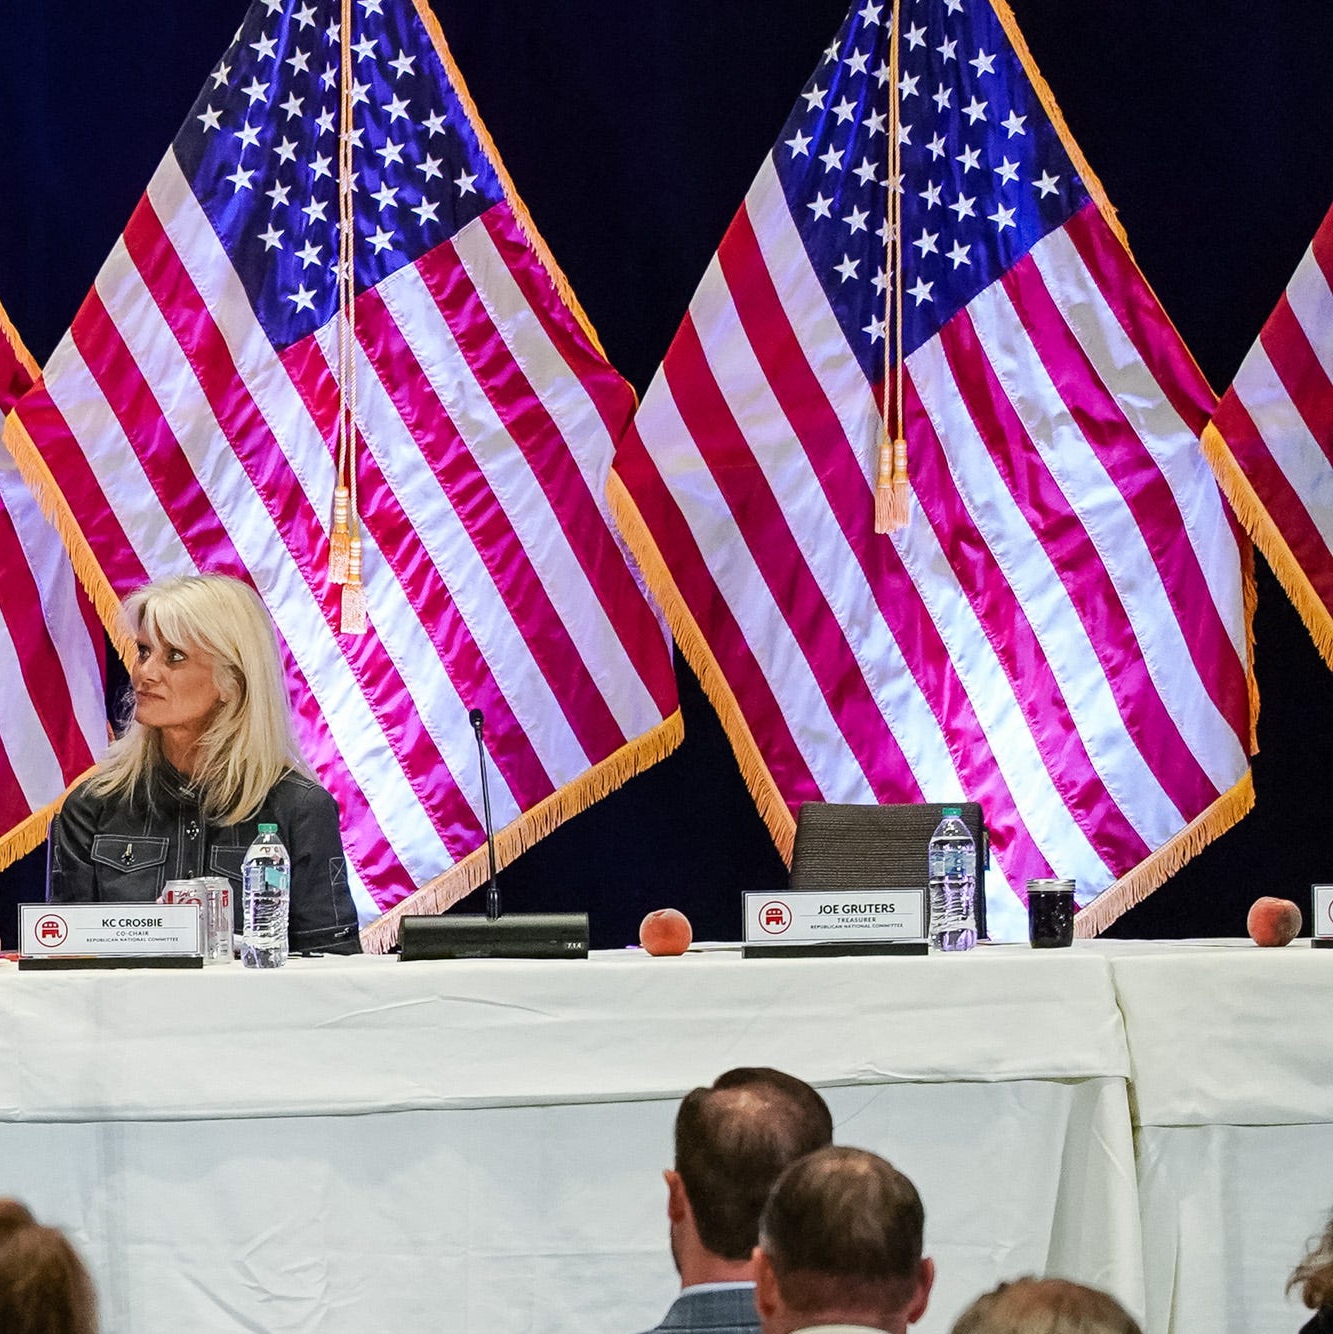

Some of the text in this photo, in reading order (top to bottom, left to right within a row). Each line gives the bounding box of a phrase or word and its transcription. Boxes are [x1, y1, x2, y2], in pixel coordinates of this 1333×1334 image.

[817, 904, 895, 915] JOE GRUTERS
[102, 918, 163, 928] KC CROSBIE
